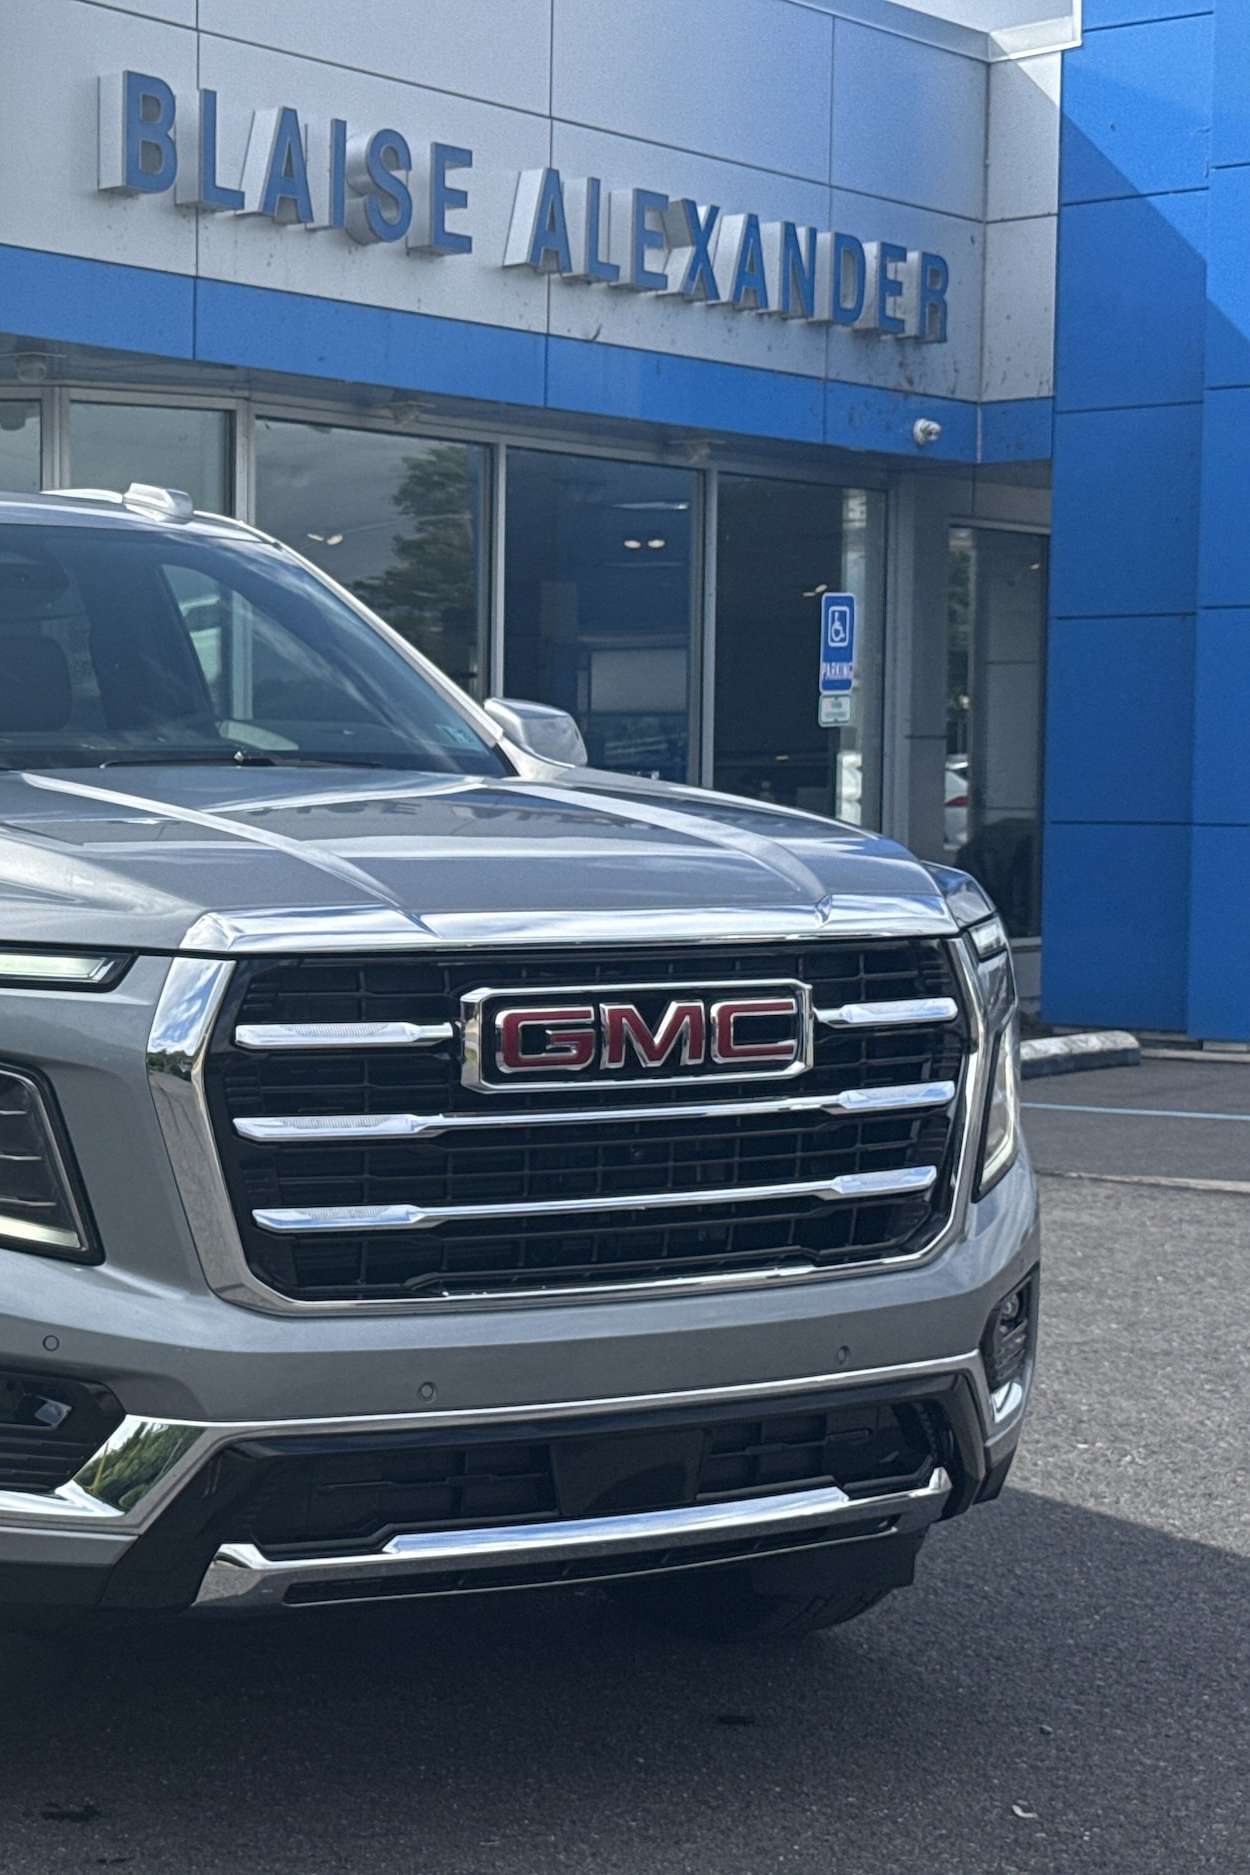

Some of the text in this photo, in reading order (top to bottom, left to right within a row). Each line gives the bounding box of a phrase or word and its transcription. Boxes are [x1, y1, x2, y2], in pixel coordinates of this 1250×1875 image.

[118, 69, 951, 344] BLAISE ALEXANDER
[495, 998, 798, 1075] GMC
